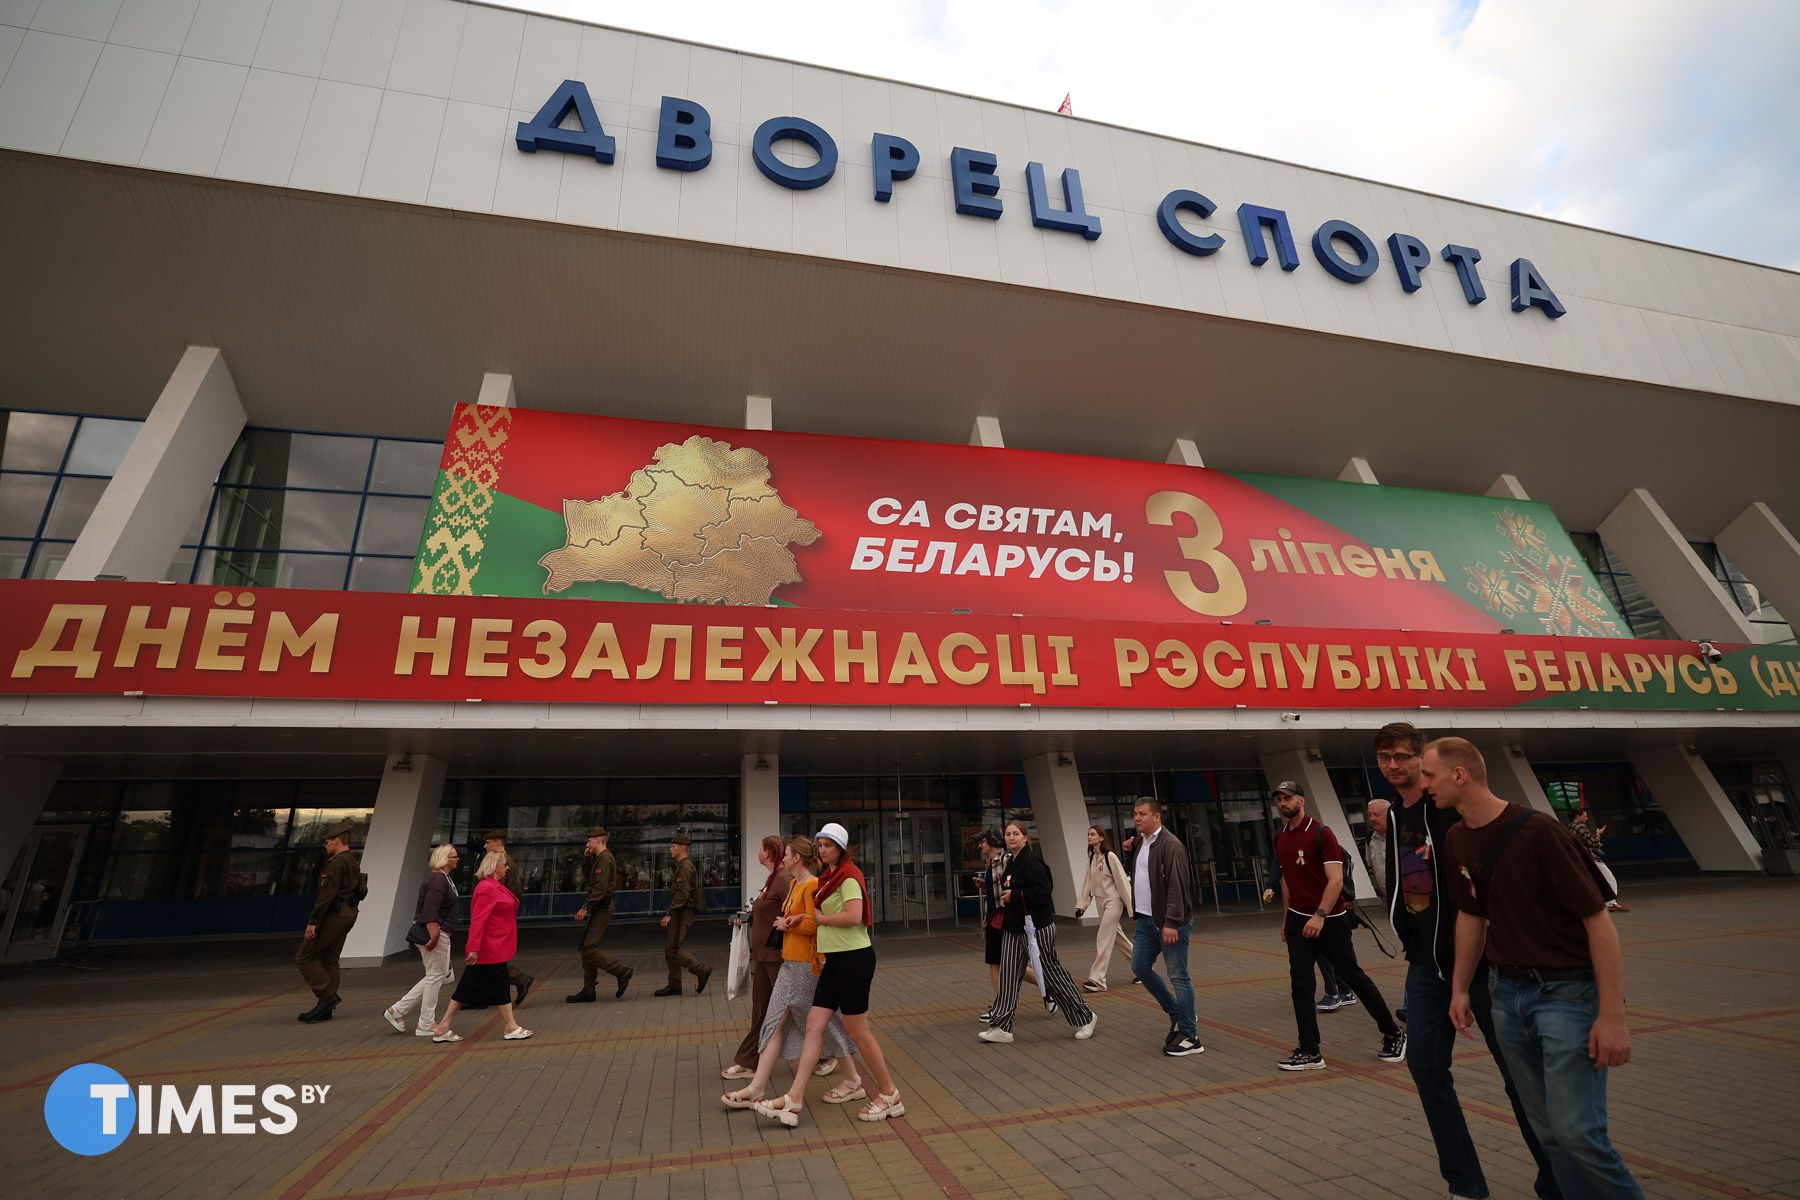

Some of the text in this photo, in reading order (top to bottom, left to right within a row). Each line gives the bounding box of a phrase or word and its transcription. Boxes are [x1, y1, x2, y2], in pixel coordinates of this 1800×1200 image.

[515, 79, 1567, 319] ДВОРЕЦ СПОРТА
[850, 537, 1134, 583] БЕЛАРУСЬ!
[867, 497, 1124, 542] СА СВЯТАМ,
[1145, 491, 1447, 617] 3 ліпеня
[10, 591, 340, 679] ДНЁМ
[394, 615, 1079, 694] НЕЗАЛЕЖНАСЦІ
[1113, 637, 1486, 691] РЭСПУБЛІКІ
[1503, 649, 1738, 695] БЕЛАРУСЬ
